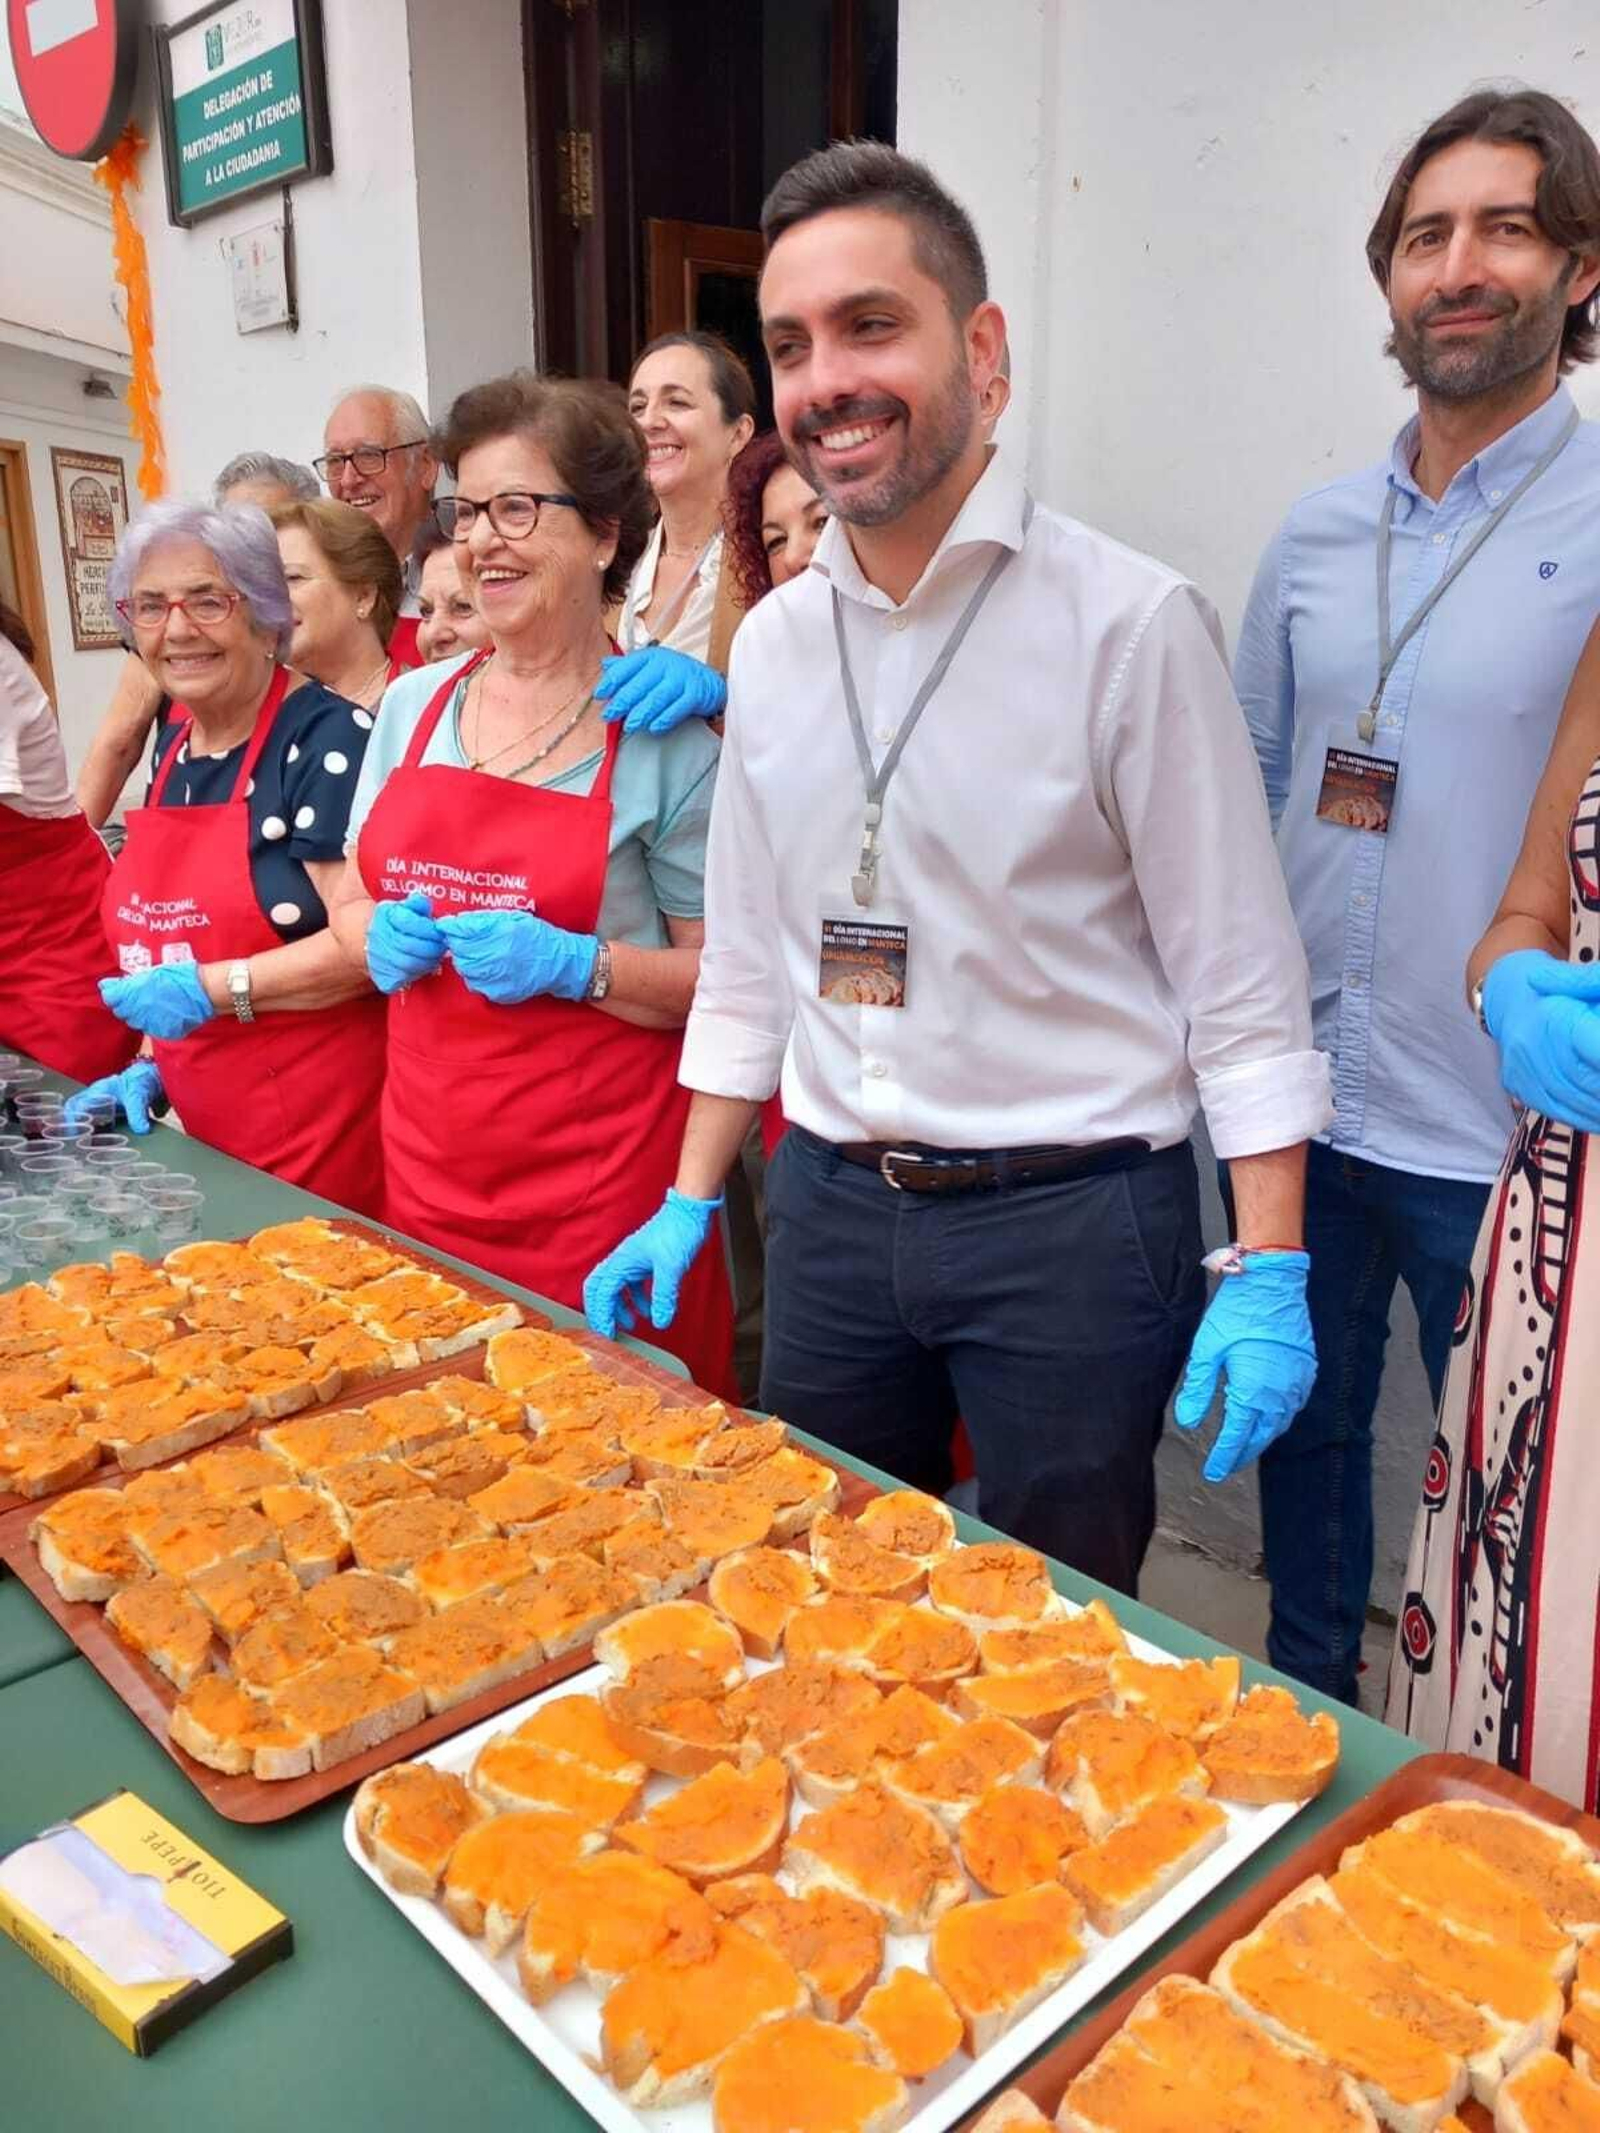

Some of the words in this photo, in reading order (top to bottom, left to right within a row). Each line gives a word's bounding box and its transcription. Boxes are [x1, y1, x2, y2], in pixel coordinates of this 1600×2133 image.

[203, 78, 260, 119] DELEGACIÓN
[260, 70, 274, 92] DE
[183, 119, 246, 163] PARTICIPACIÓN
[246, 114, 255, 132] Y
[255, 92, 302, 131] ATENCIÓN
[205, 169, 213, 186] A
[214, 163, 226, 183] LA
[386, 857, 407, 874] DÍA
[412, 861, 530, 890] INTERNACIONAL
[400, 880, 446, 900] LOMO
[450, 887, 466, 904] EN
[149, 913, 212, 932] MANTECA
[846, 926, 906, 940] INTERNACIONAL
[141, 1830, 186, 1867] PEPE
[191, 1872, 227, 1900] TIO
